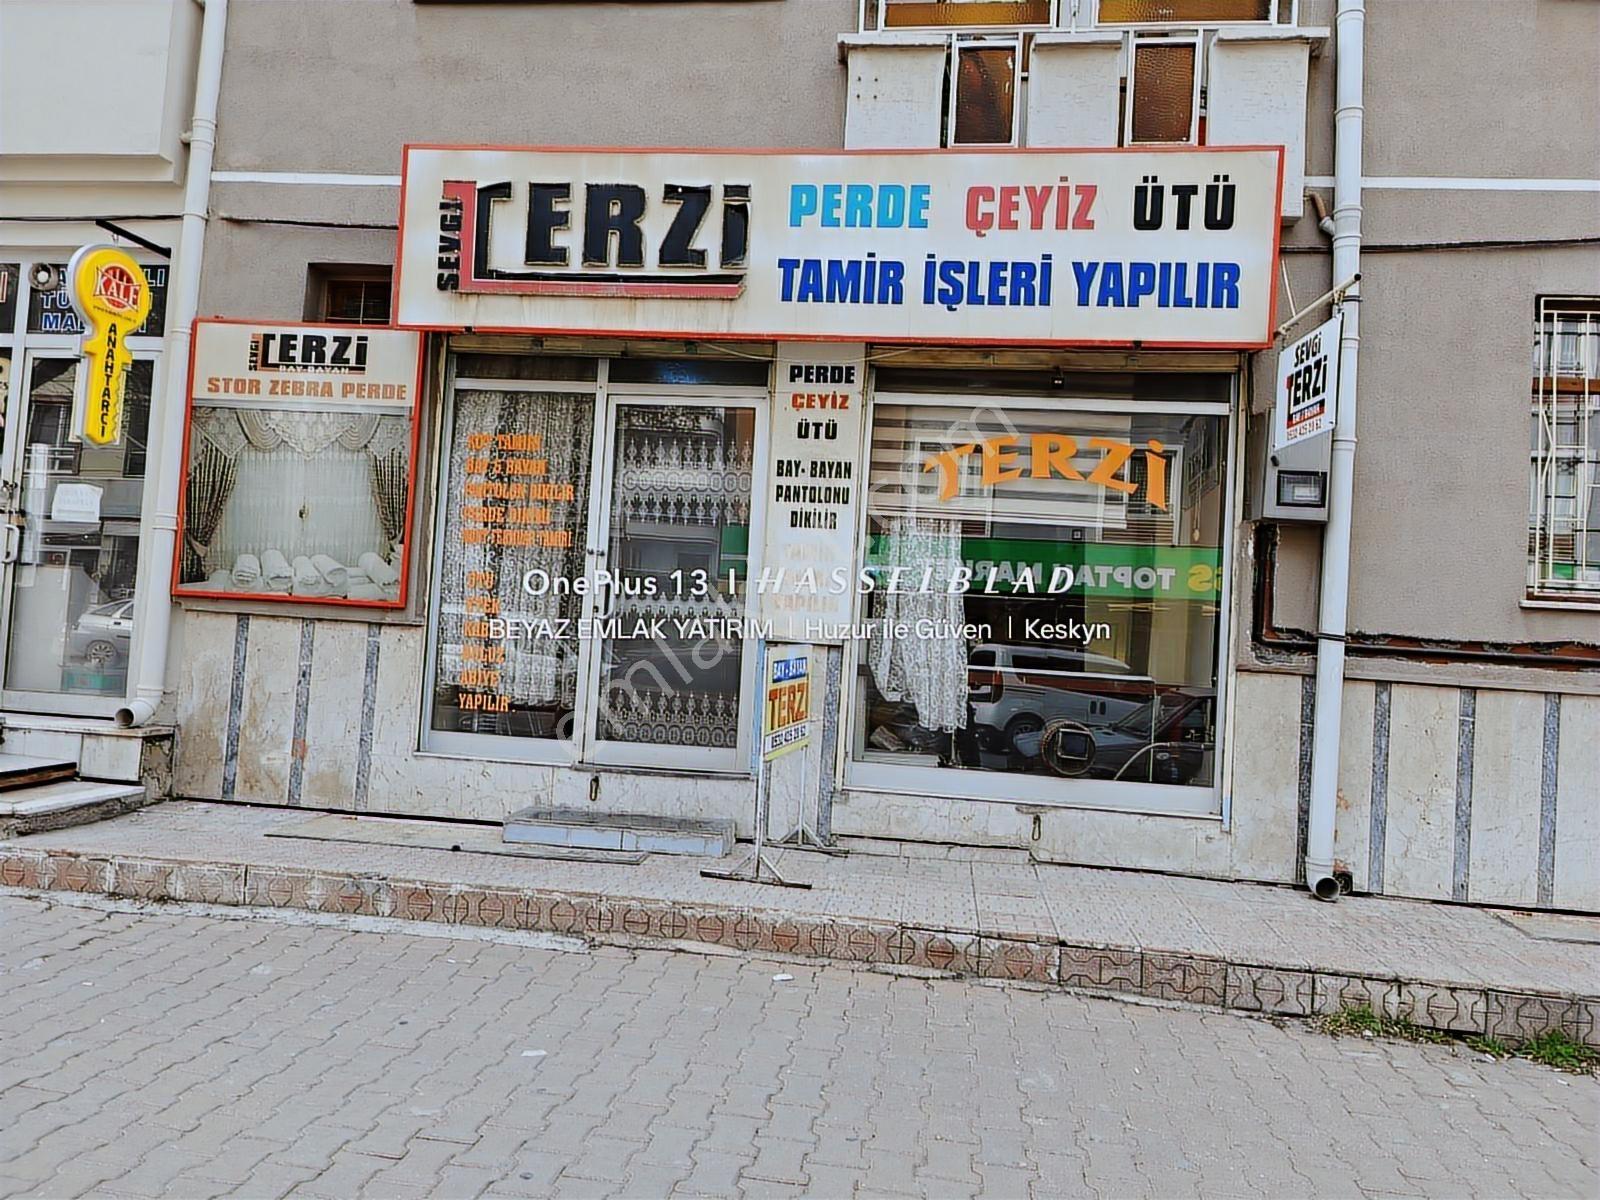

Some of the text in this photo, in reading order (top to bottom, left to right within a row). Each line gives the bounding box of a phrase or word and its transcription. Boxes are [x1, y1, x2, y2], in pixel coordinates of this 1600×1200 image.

[789, 174, 1236, 237] PERDE ÇEYİZ ÜTÜ
[95, 269, 139, 310] KALE
[778, 252, 1241, 311] TAMİR İŞLERİ YAPILIR
[100, 323, 117, 437] ANAHTARCI
[789, 364, 856, 384] PERDE
[207, 377, 407, 400] STOR ZEBRA PERDE
[791, 391, 850, 412] ÇEYİZ
[797, 418, 838, 440] ÜTÜ
[810, 461, 852, 479] BAYAN
[775, 485, 850, 505] PANTOLONU
[790, 508, 837, 529] DİKİLİR
